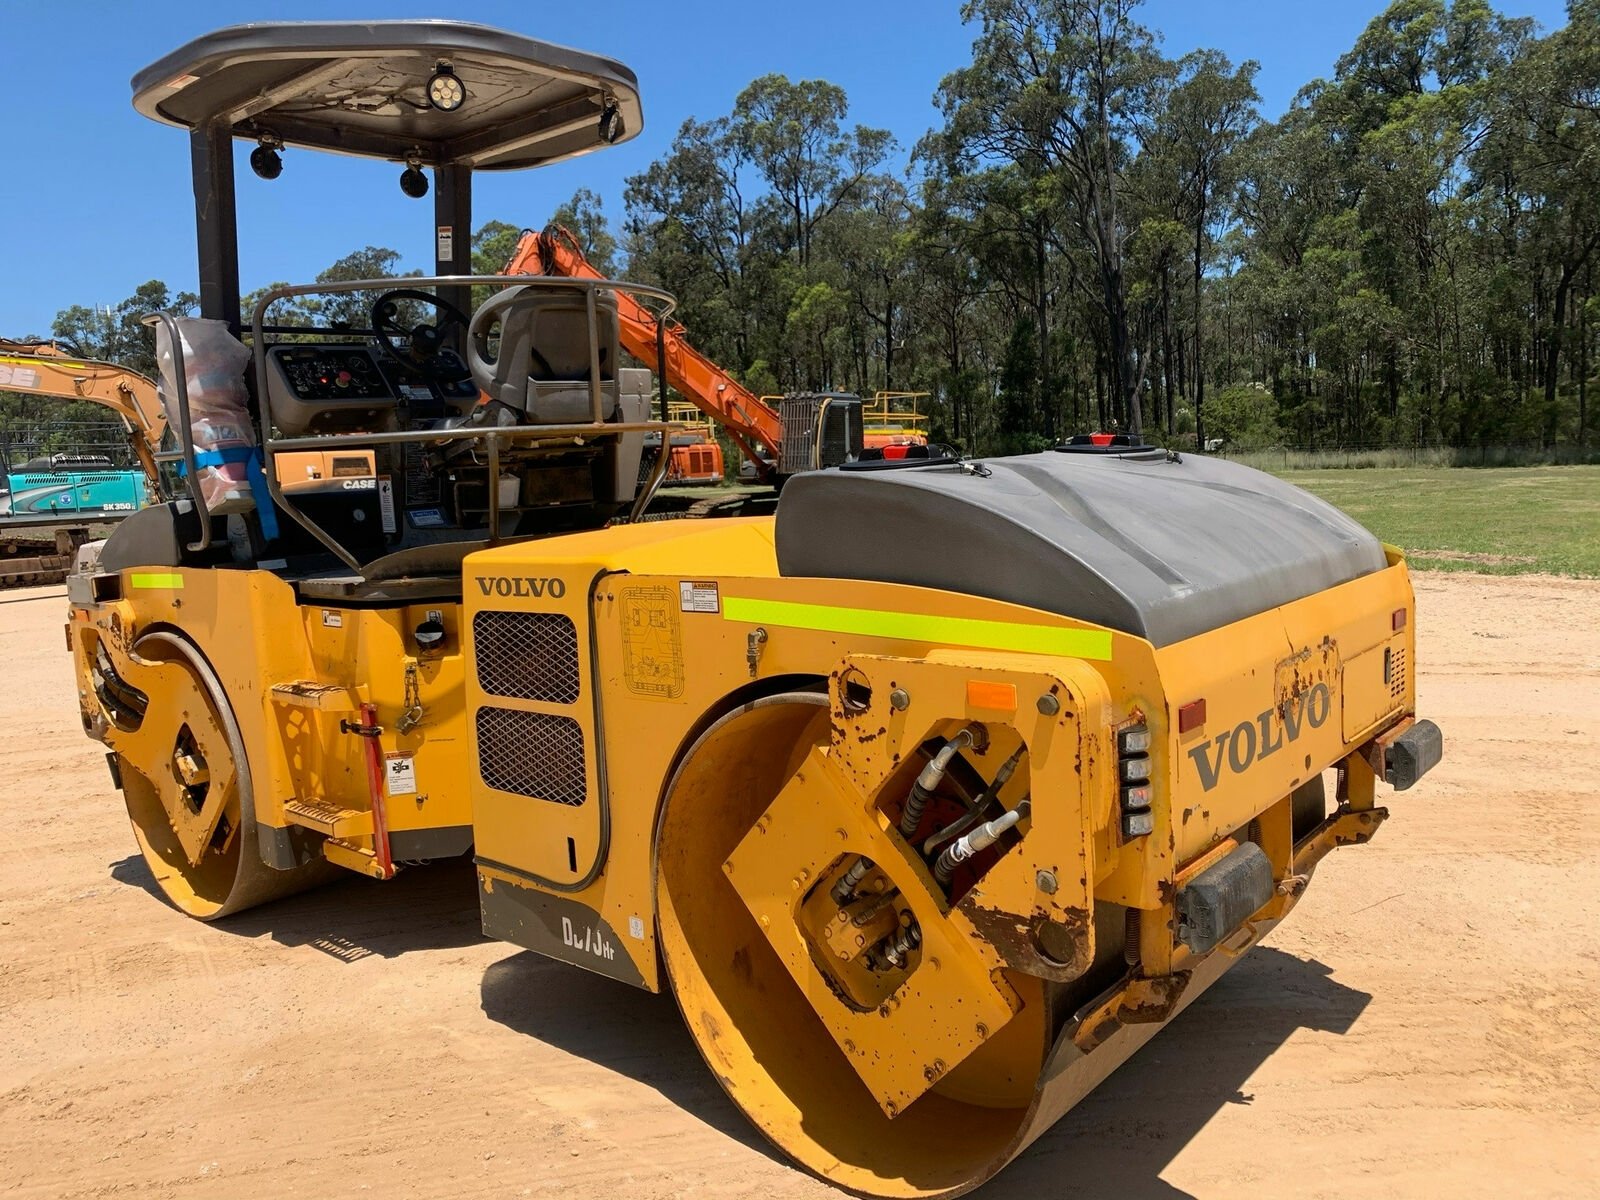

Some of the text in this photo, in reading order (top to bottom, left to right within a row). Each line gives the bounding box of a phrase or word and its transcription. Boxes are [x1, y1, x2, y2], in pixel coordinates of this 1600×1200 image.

[342, 479, 376, 490] CASE
[103, 502, 131, 511] SK350
[475, 577, 566, 599] VOLVO
[1187, 682, 1330, 793] VOLVO
